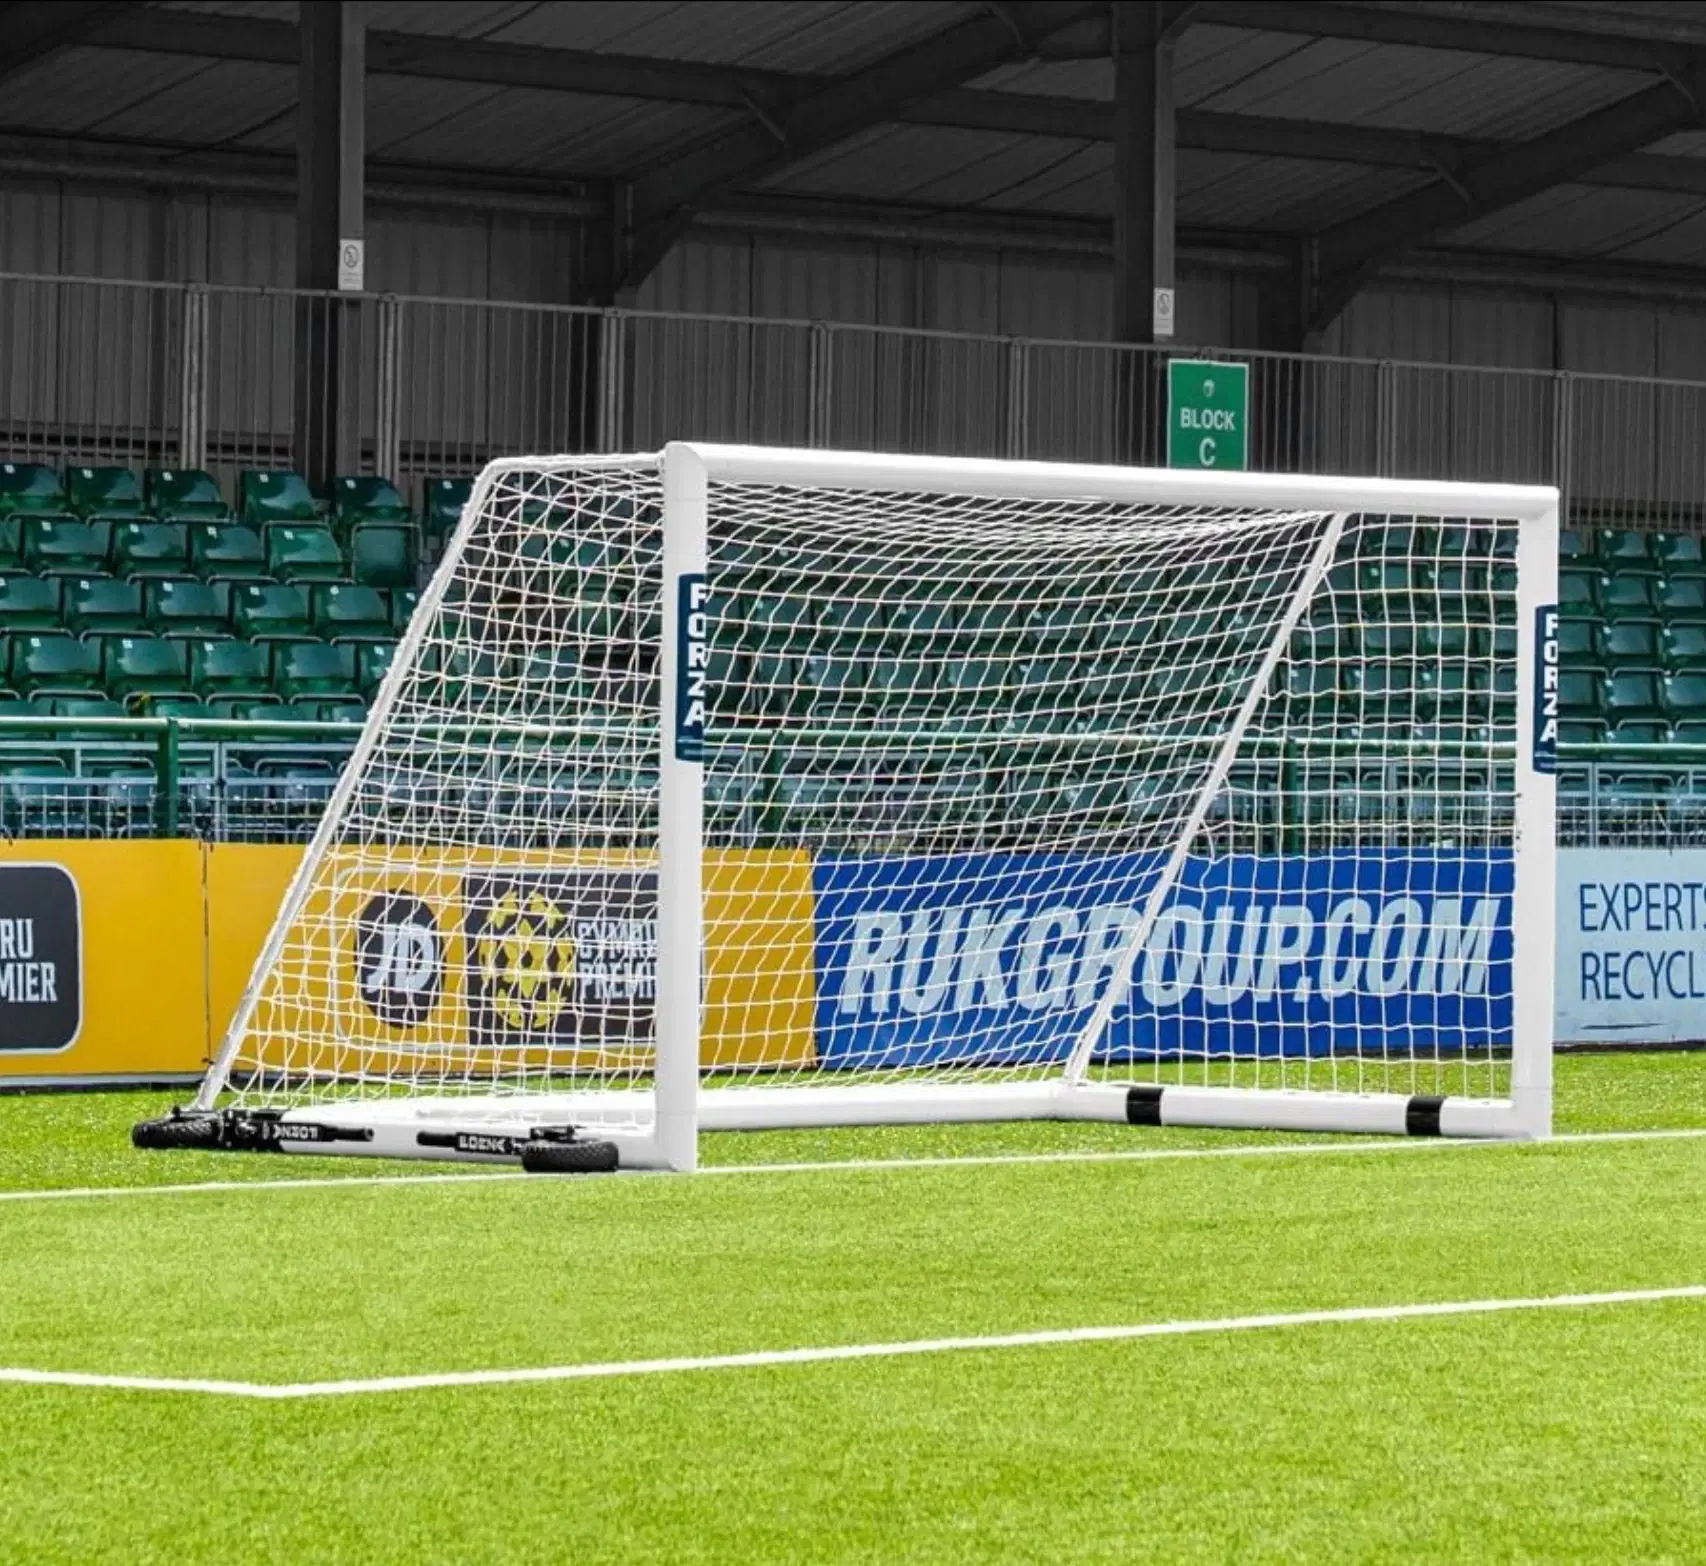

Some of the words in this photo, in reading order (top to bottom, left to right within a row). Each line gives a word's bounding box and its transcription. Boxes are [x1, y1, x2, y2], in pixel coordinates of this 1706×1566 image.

[1180, 408, 1235, 430] BLOCK
[1199, 437, 1216, 466] C
[683, 583, 707, 727] FORZA
[1540, 613, 1558, 742] FORZA
[1579, 883, 1706, 932] EXPERT
[367, 923, 435, 993] JD
[841, 898, 1500, 1014] RUKGROUP.COM
[1581, 951, 1706, 1000] RECYCL
